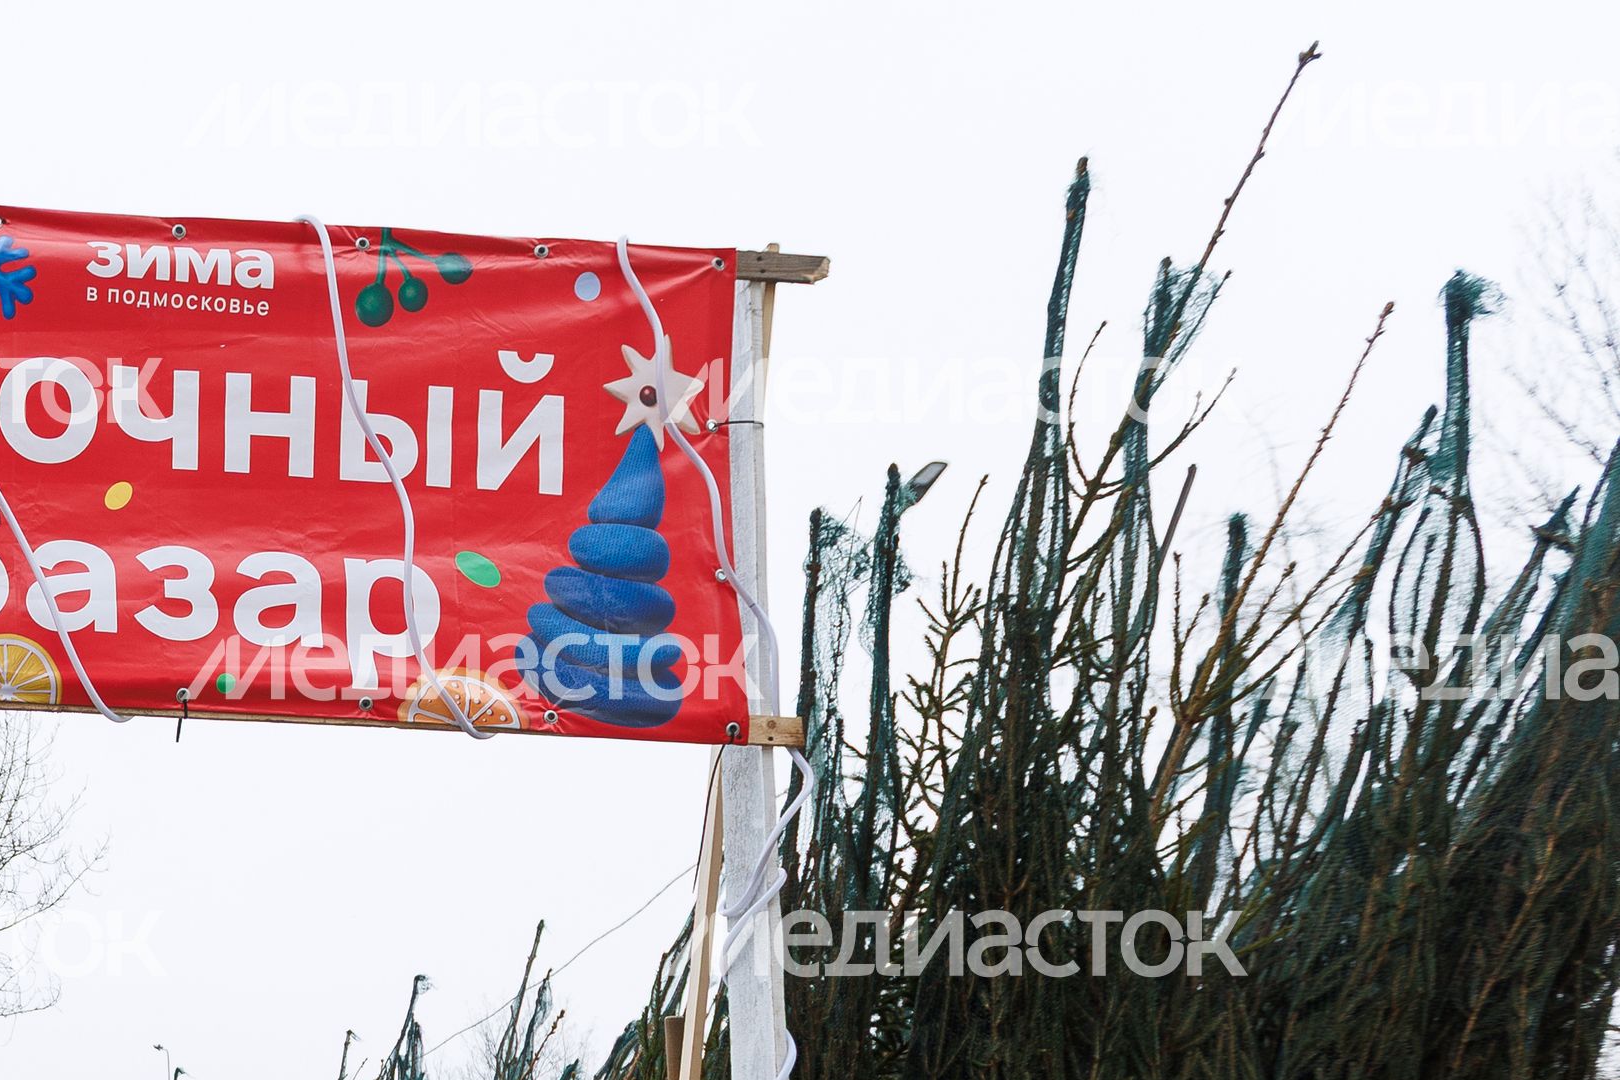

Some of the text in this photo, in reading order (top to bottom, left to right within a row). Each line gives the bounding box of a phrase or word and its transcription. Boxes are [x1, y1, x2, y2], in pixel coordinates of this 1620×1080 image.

[85, 241, 275, 290] зима
[86, 286, 270, 316] в подмосковье
